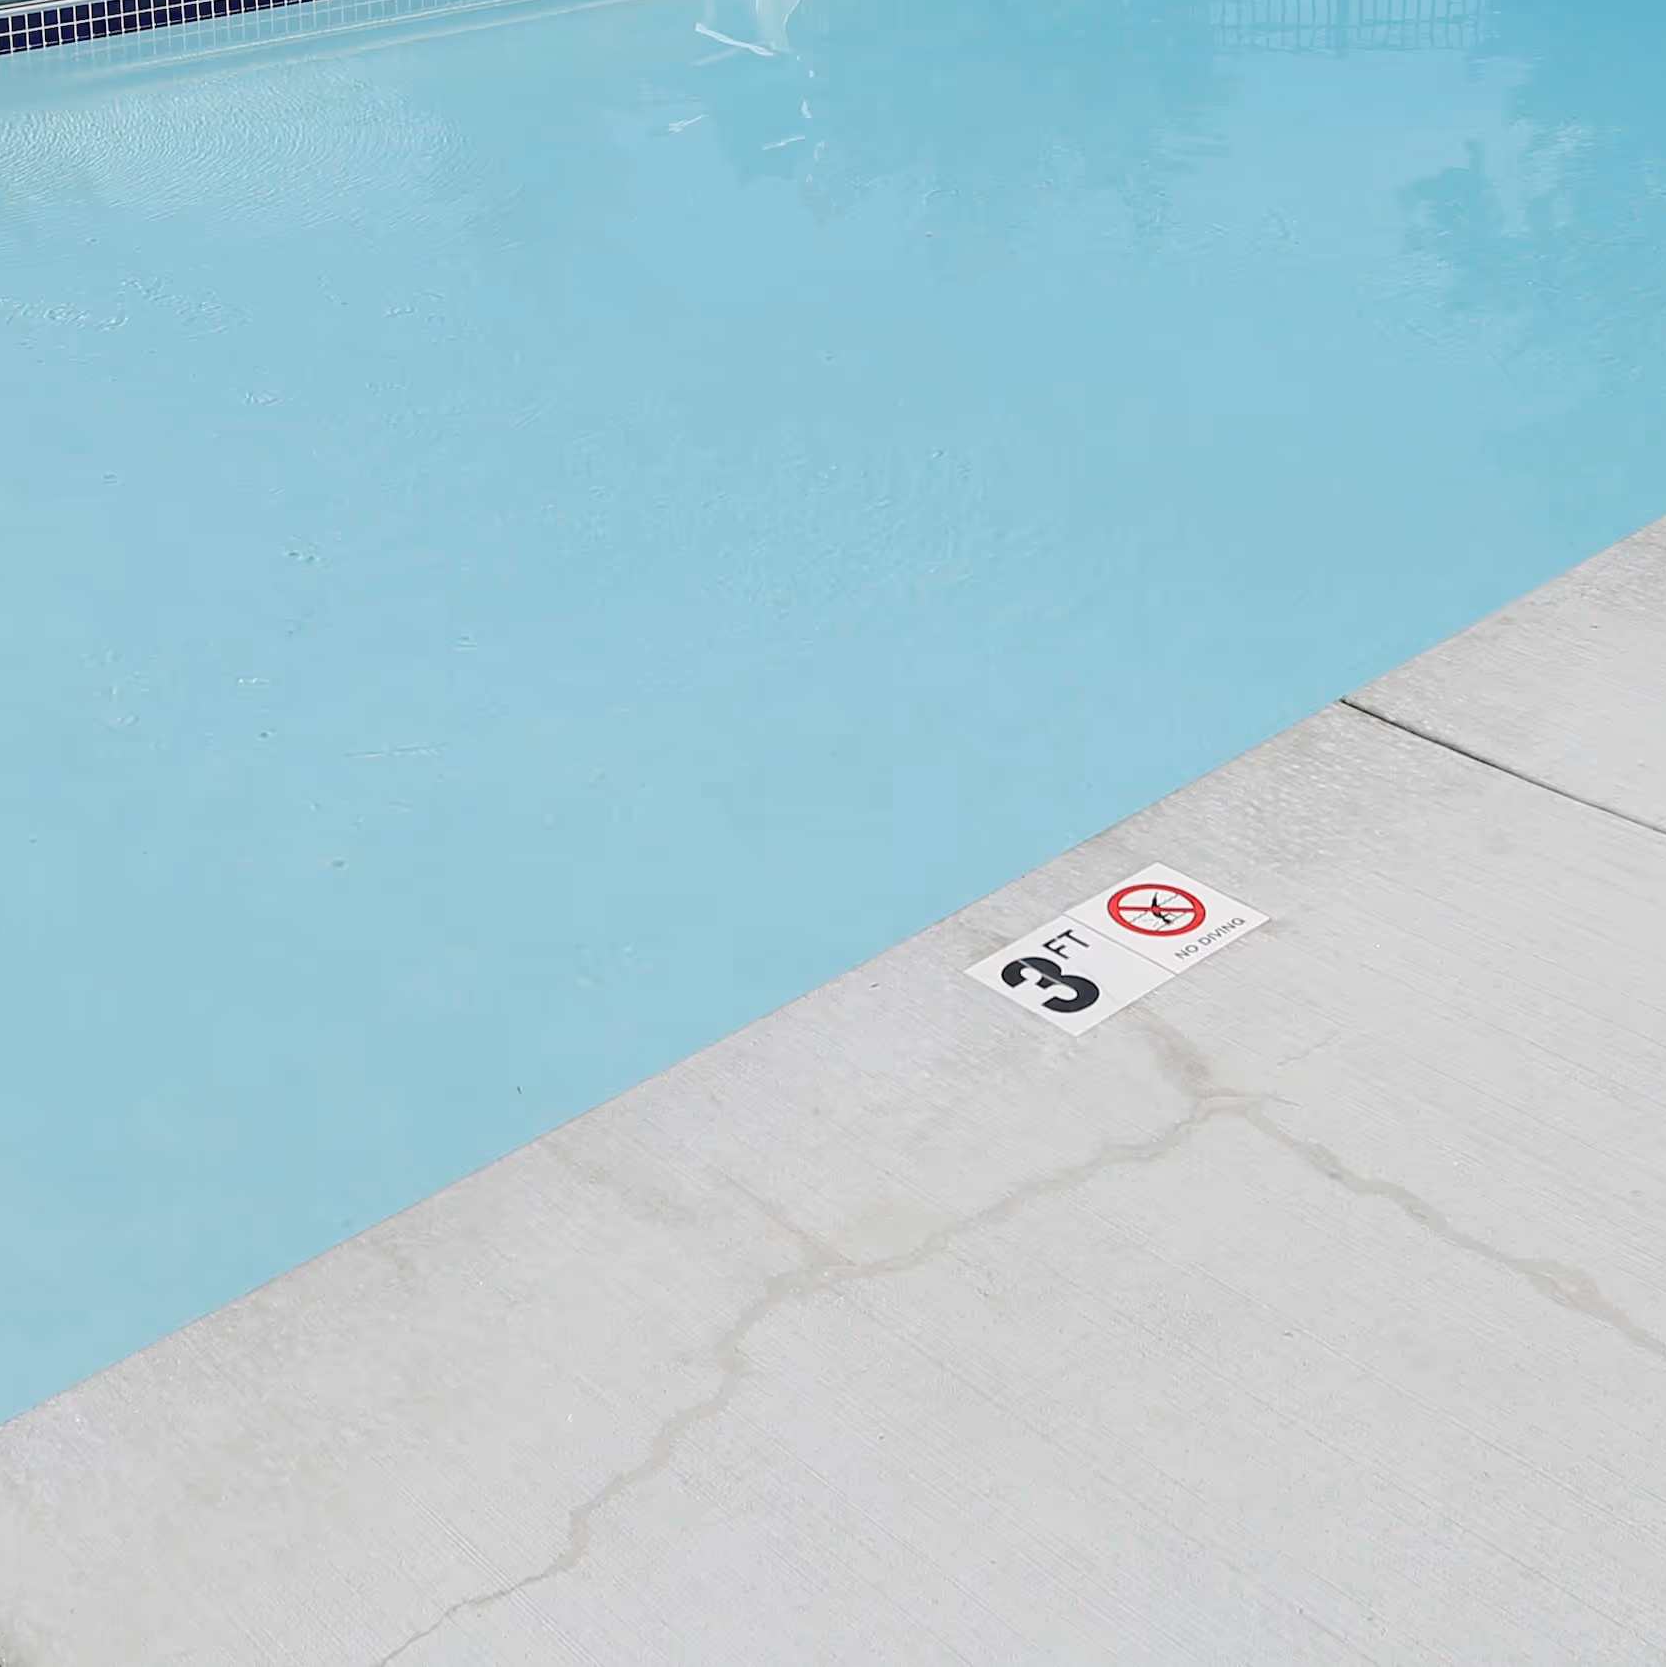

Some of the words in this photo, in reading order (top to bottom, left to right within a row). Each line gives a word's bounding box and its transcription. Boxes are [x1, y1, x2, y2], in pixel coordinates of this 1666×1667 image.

[1041, 929, 1090, 960] FT
[1174, 944, 1199, 960] NO
[1198, 917, 1246, 946] DIVING
[1001, 957, 1100, 1013] 3
